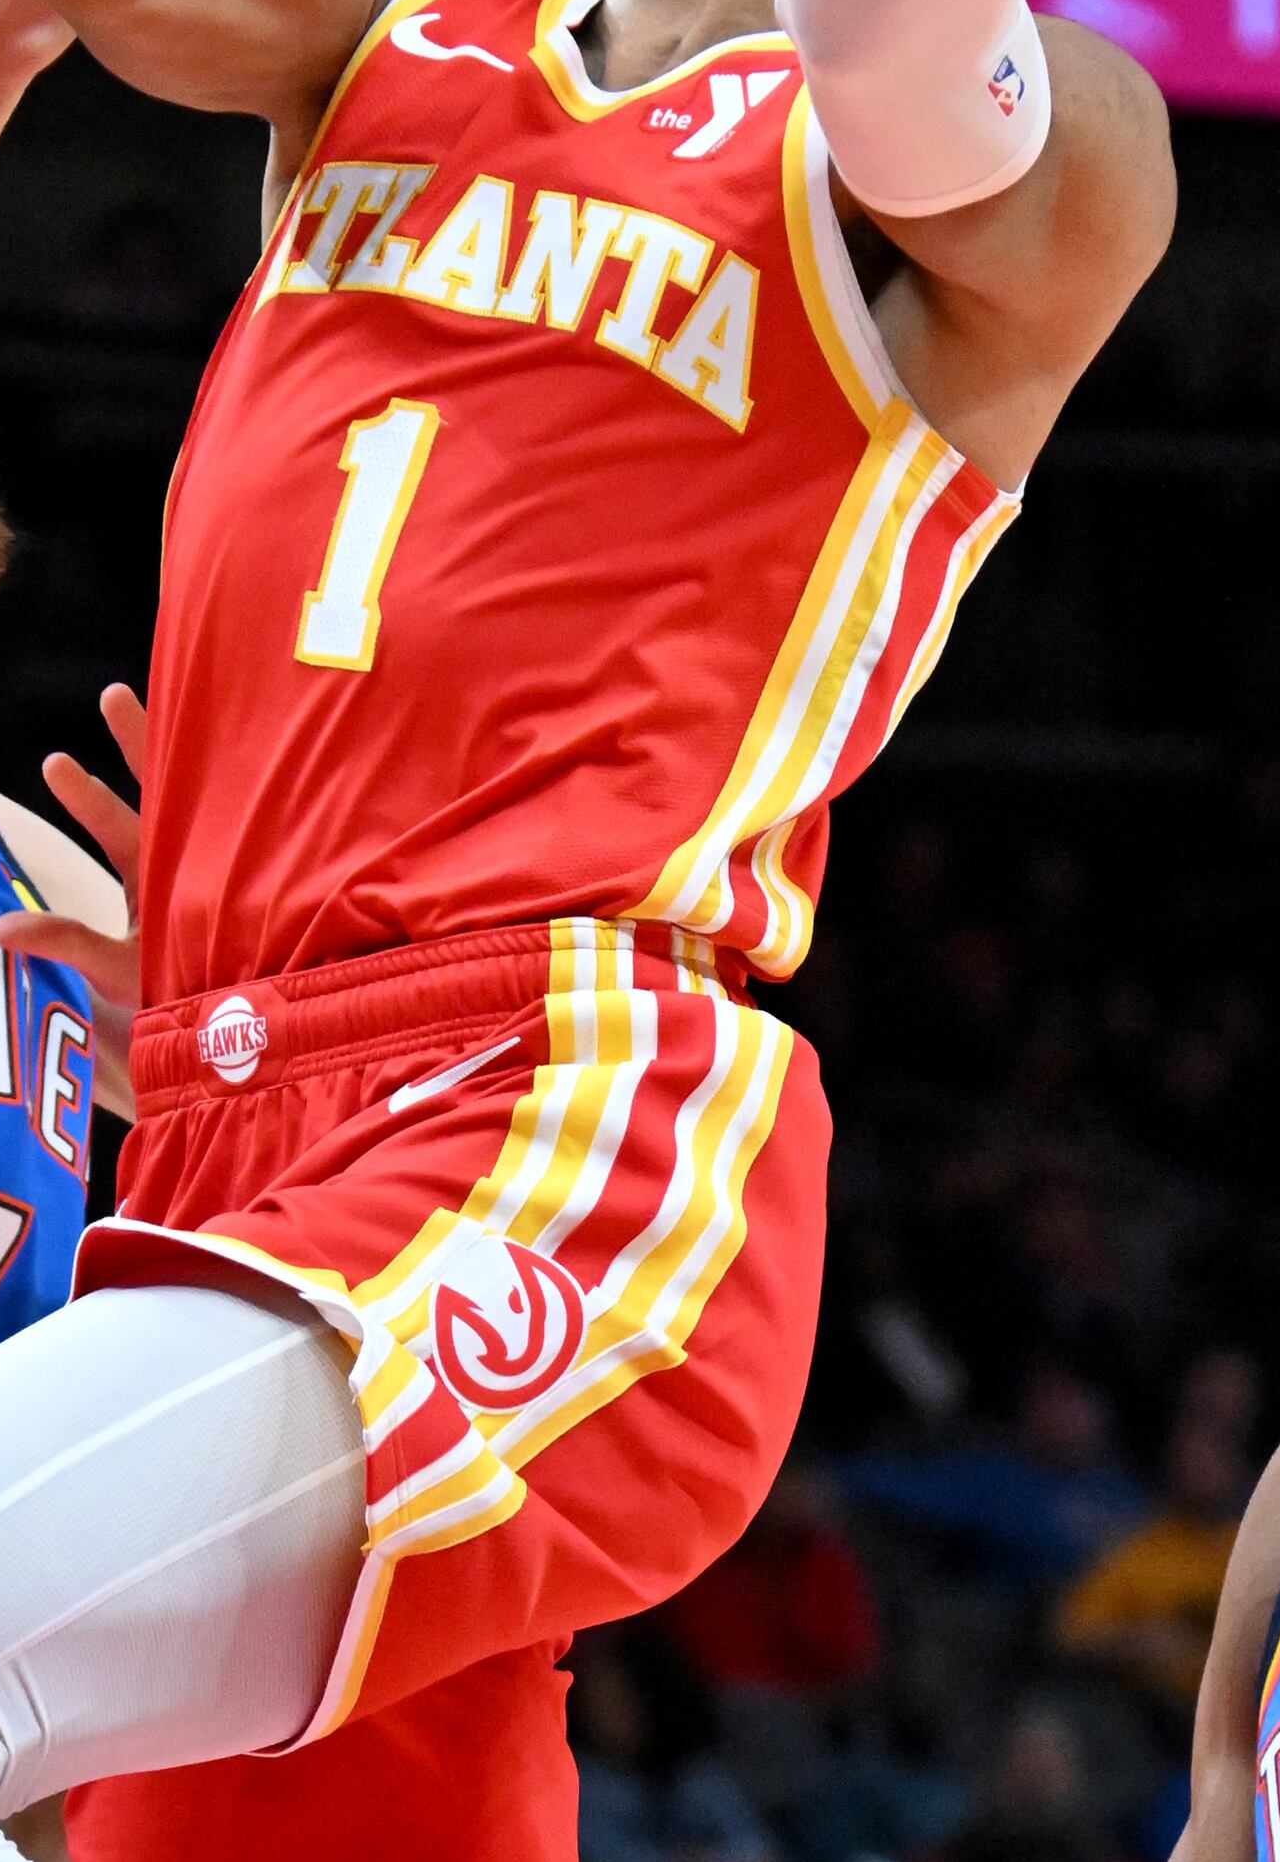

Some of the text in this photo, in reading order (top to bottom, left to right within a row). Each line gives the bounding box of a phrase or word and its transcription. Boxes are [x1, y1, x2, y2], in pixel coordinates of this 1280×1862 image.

[649, 107, 692, 130] the
[294, 398, 441, 671] 1
[197, 1018, 268, 1062] HAWKS
